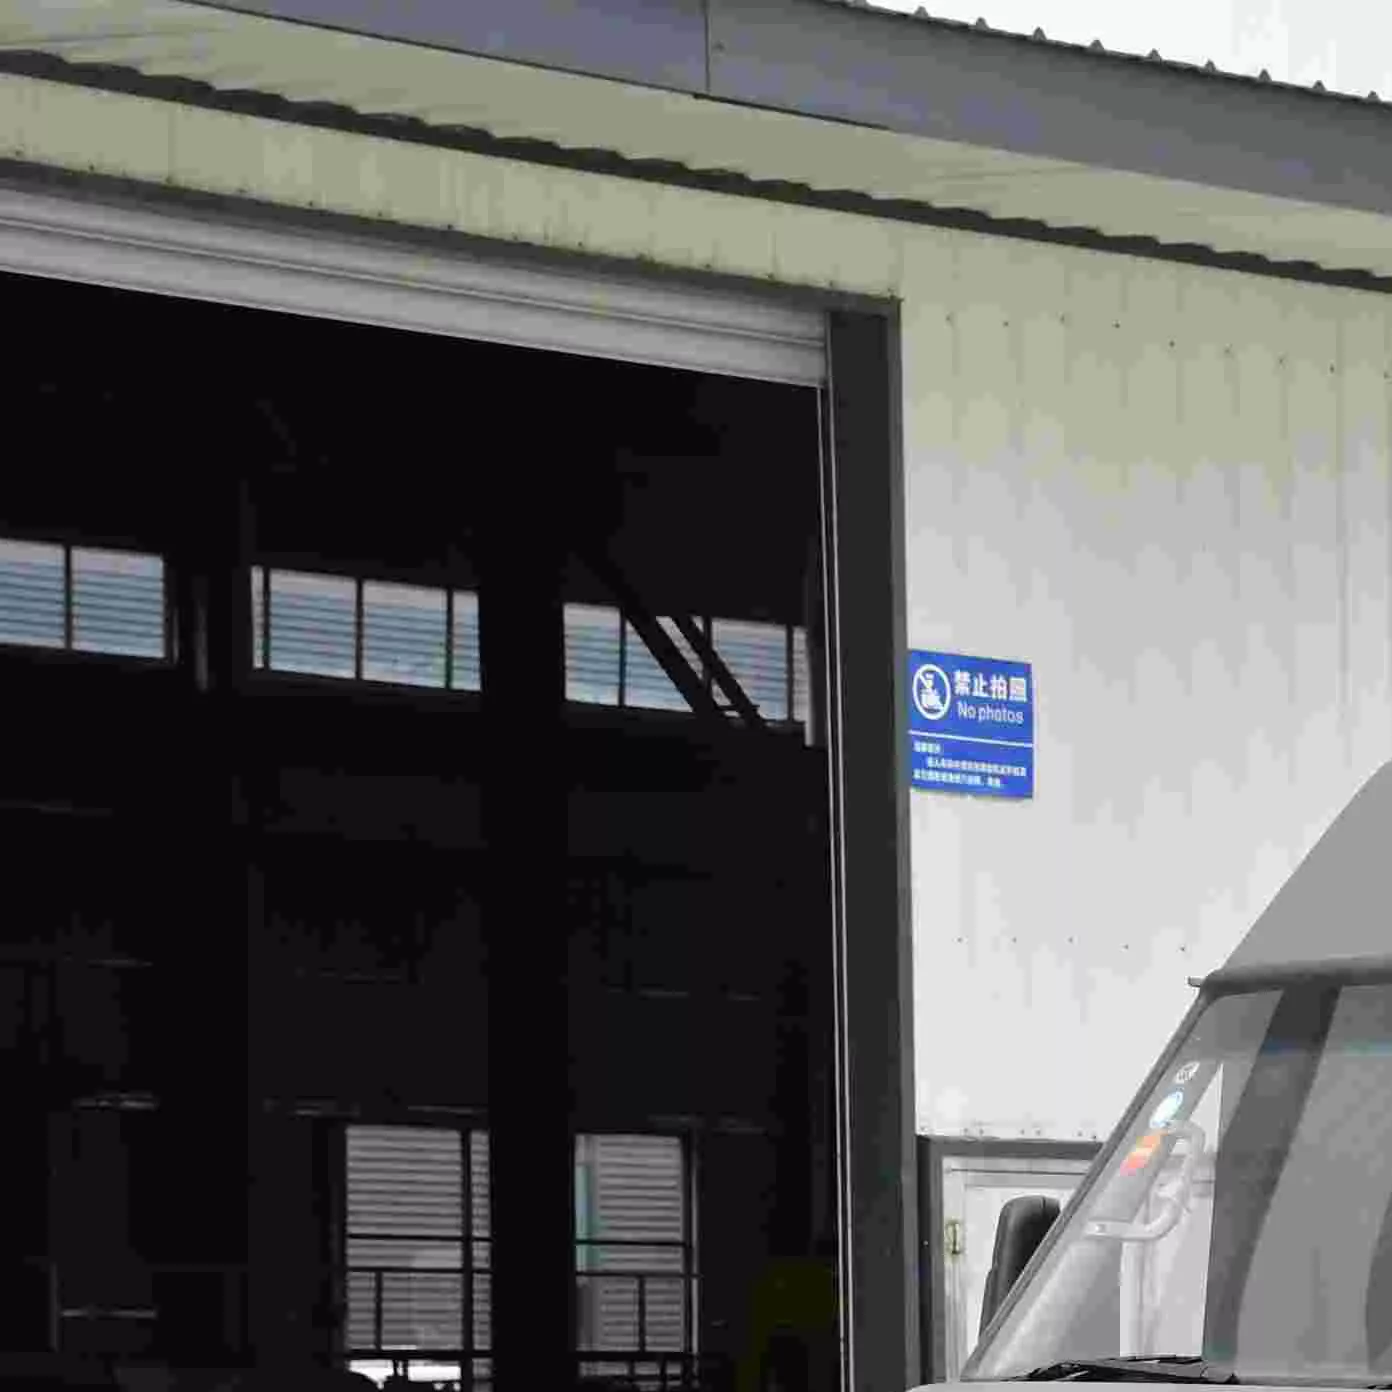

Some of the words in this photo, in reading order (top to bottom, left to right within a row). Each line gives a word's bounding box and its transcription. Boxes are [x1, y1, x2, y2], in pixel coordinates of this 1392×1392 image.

[954, 669, 1027, 703] 禁止拍照
[957, 701, 976, 719] No
[978, 703, 1025, 724] photos
